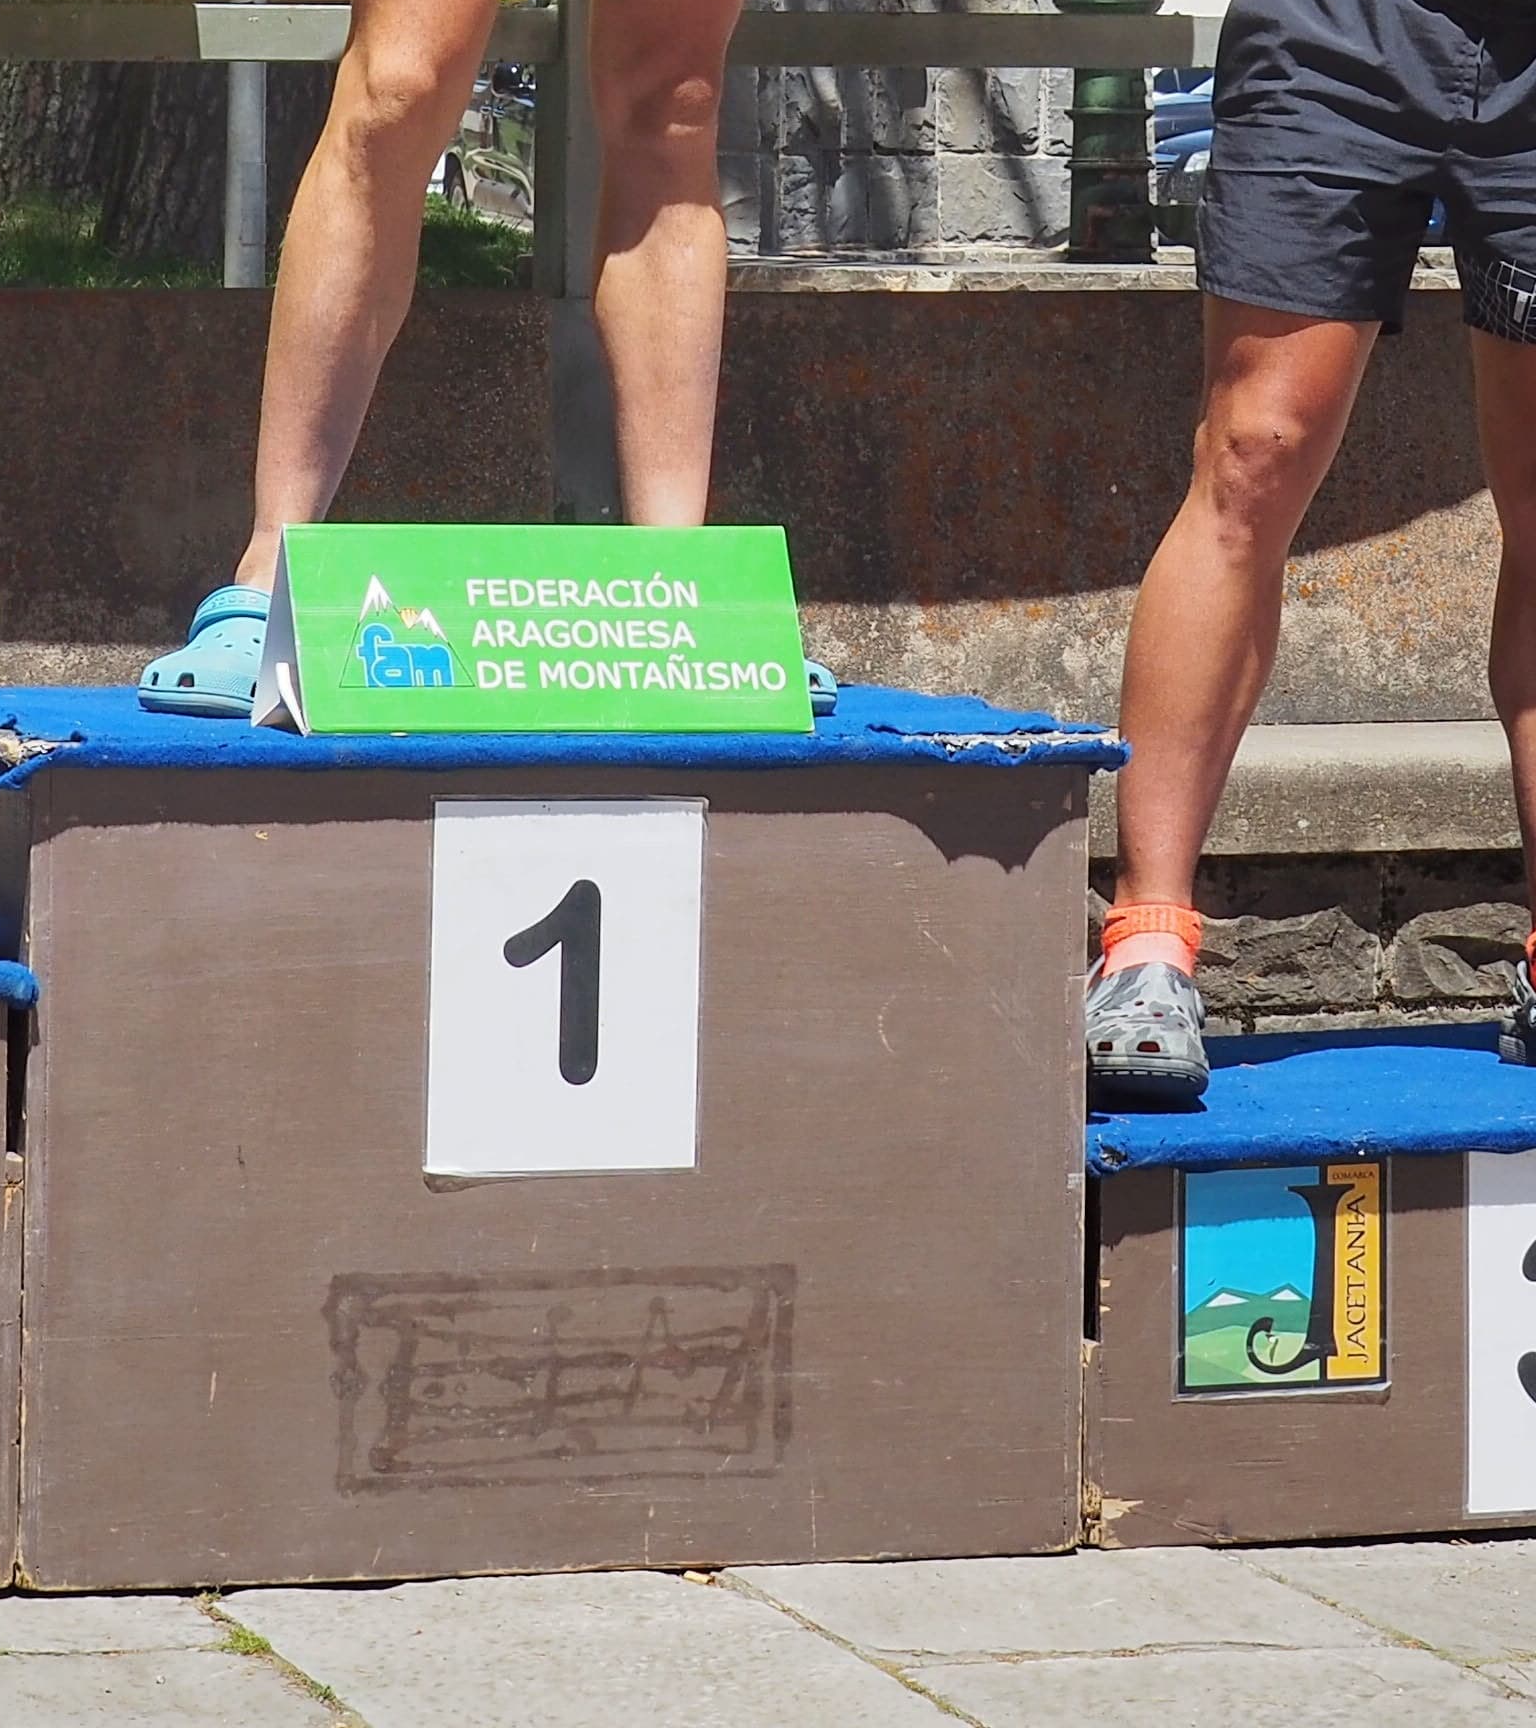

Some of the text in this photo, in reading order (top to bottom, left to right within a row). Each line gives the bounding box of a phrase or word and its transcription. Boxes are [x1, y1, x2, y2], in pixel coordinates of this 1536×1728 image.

[466, 572, 698, 609] FEDERACIÓN
[355, 622, 454, 687] fam
[472, 620, 696, 649] ARAGONESA
[477, 654, 787, 692] DE MONTAÑISMO
[503, 879, 601, 1085] 1
[1347, 1194, 1369, 1364] JACETANIA
